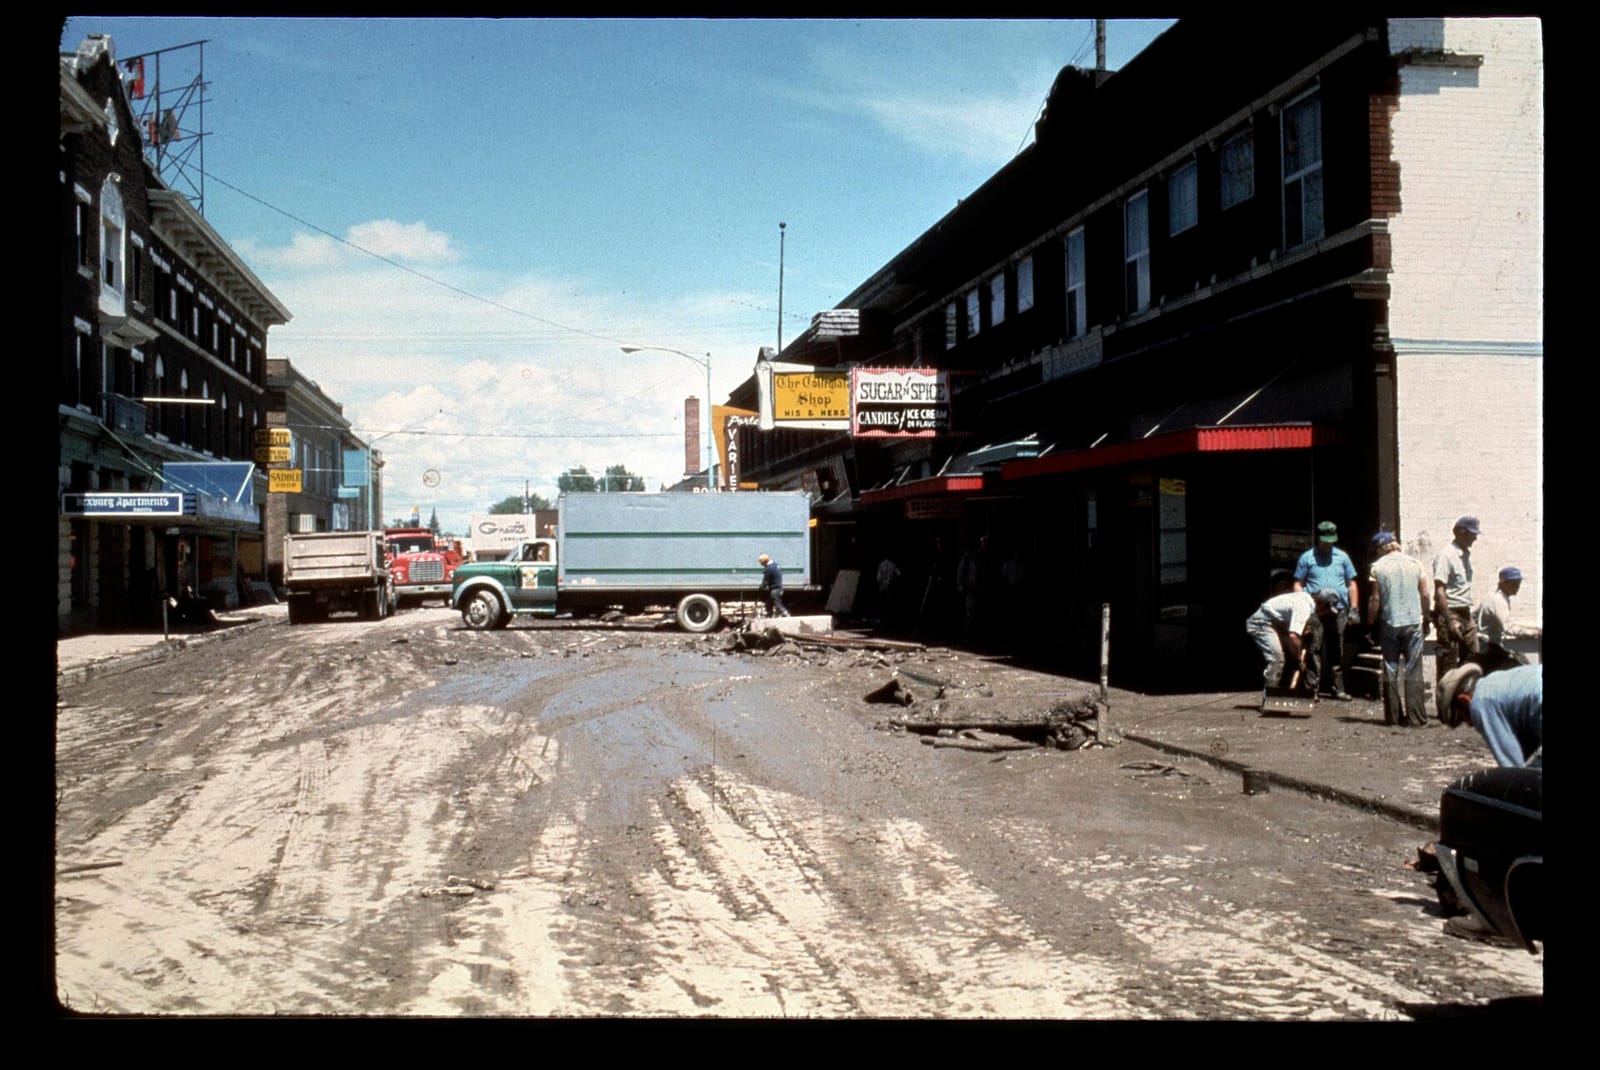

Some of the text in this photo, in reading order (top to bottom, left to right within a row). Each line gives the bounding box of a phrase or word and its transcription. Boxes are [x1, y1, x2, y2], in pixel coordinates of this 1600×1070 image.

[776, 375, 801, 392] The
[860, 382, 903, 400] SUGAR
[911, 382, 944, 401] SPICE
[797, 392, 832, 408] Shop
[857, 411, 900, 425] CANDIES
[907, 409, 948, 419] ICE CREAM
[271, 473, 300, 482] SADDLE
[116, 497, 170, 508] Apartments
